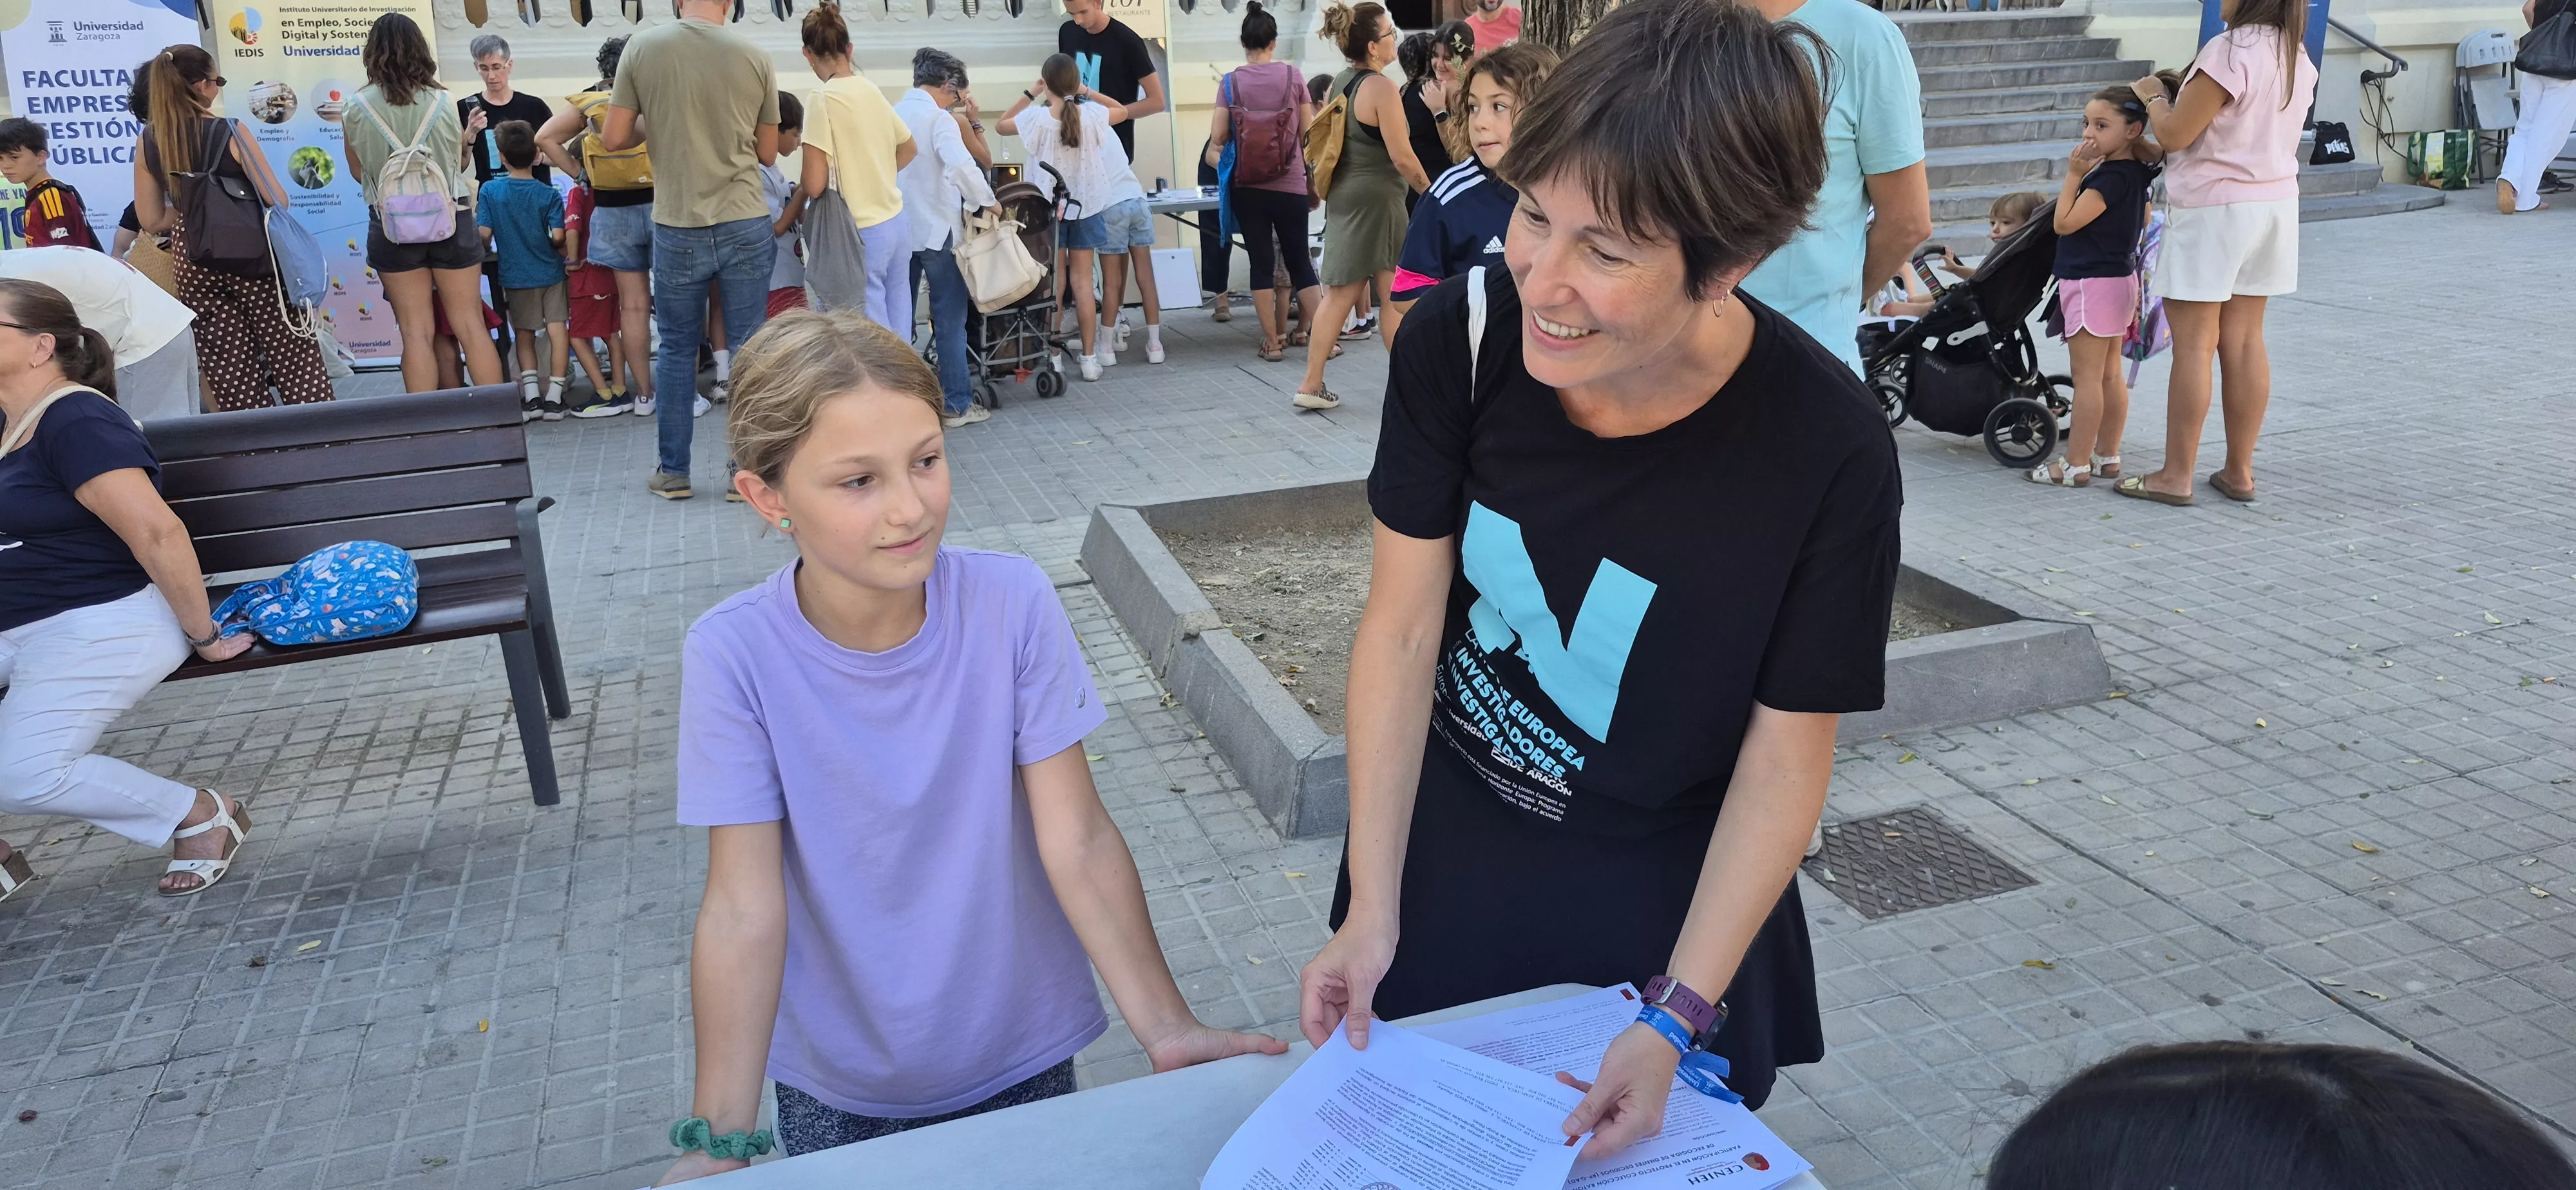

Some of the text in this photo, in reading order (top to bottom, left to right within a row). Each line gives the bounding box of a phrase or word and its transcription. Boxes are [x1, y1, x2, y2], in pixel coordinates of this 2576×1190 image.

[73, 21, 144, 32] Universidad
[298, 19, 341, 29] Empleo,
[345, 18, 375, 26] Socie
[75, 33, 121, 42] Zaragoza
[282, 30, 370, 42] Digital y Sosteni
[234, 48, 264, 57] IEDIS
[283, 45, 361, 56] Universidad
[23, 69, 138, 88] FACULTA
[27, 95, 130, 114] EMPRES
[1455, 647, 1566, 778] INVESTIGADORES
[1508, 699, 1586, 771] EUROPEA
[1488, 777, 1564, 815] Horizonte Europa: Programa
[1501, 777, 1512, 786] por
[1518, 784, 1535, 797] Unión
[1535, 791, 1558, 806] Europea
[1519, 800, 1532, 810] bajo
[1539, 809, 1562, 822] acuerdo
[1669, 1145, 1704, 1158] RECOGIDA
[1634, 1157, 1660, 1167] DIENTES
[1600, 1164, 1633, 1176] DECIDUOS
[1638, 1163, 1672, 1175] PROYECTO
[1687, 1163, 1743, 1185] CENIEH
